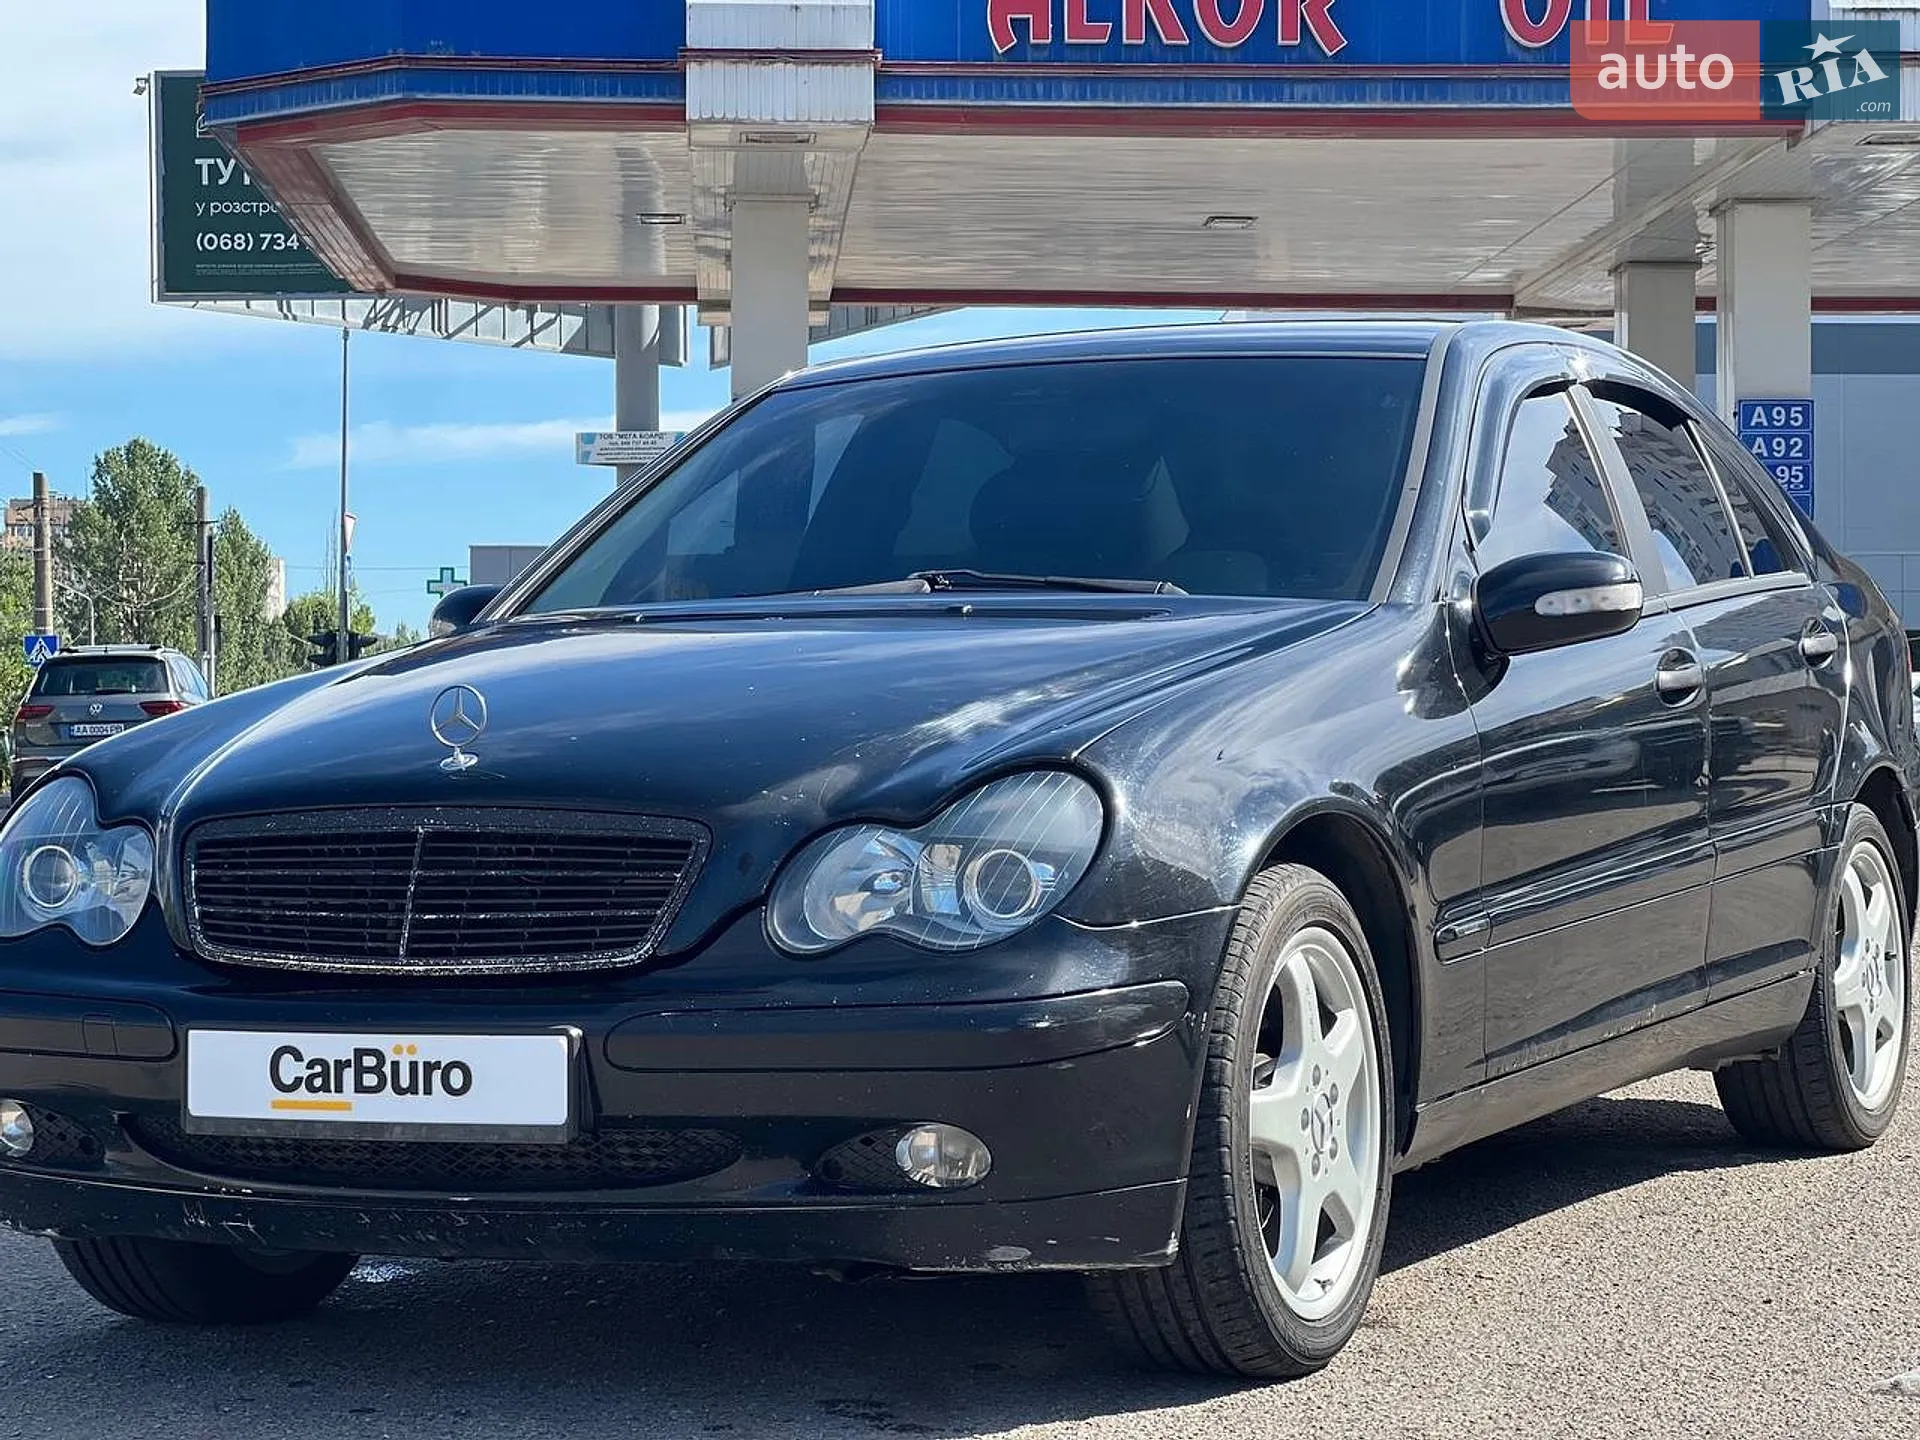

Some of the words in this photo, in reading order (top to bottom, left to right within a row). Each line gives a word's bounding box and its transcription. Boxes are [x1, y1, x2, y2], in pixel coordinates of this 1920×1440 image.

[194, 157, 251, 186] ТУ
[196, 232, 254, 251] (068)
[259, 234, 300, 250] 734
[1750, 406, 1803, 426] A95
[269, 1043, 473, 1097] CarBüro
